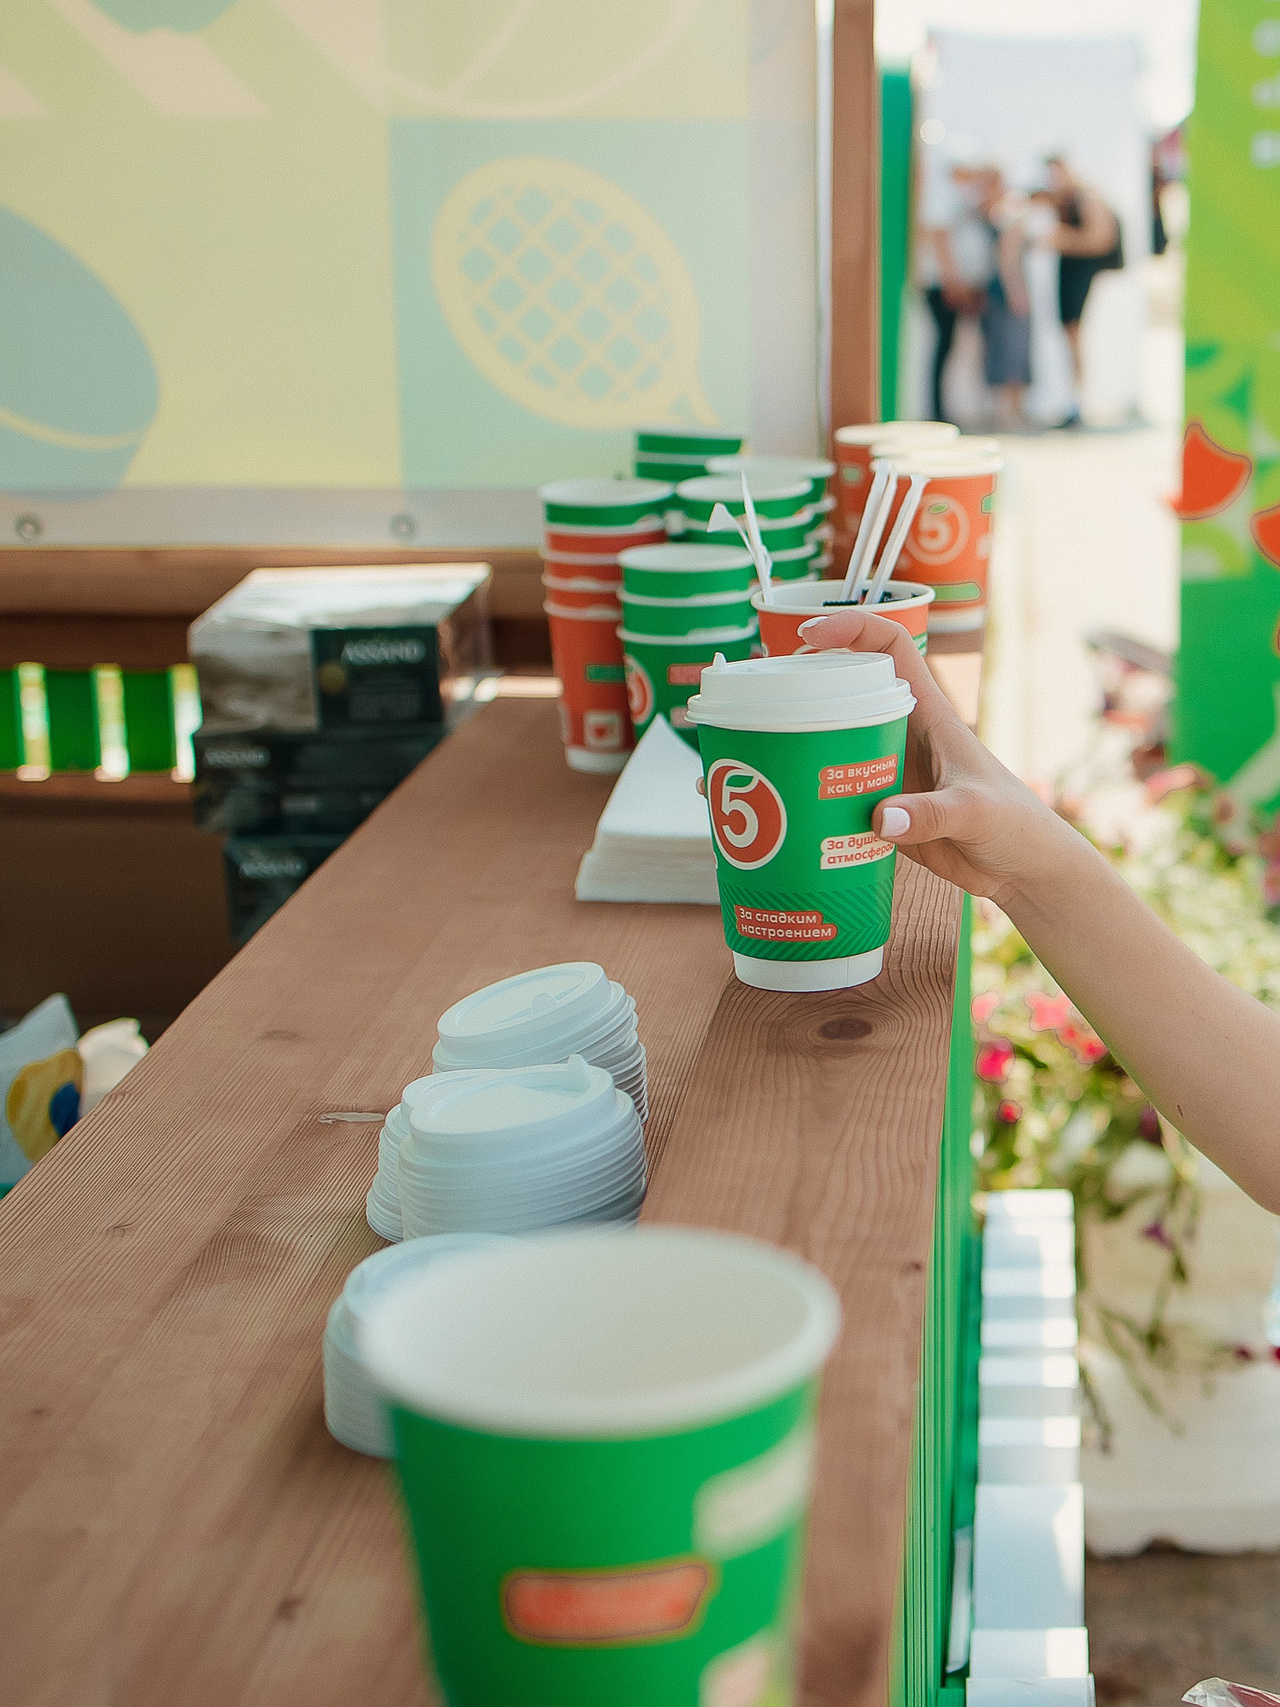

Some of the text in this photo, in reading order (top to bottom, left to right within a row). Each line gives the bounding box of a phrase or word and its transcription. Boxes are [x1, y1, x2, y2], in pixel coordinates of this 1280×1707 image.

[826, 758, 897, 780] За вкусным,
[827, 773, 894, 794] как у мамы
[721, 769, 759, 848] 5
[827, 835, 880, 850] За душе
[739, 908, 817, 923] За сладким
[740, 924, 832, 938] настроением
